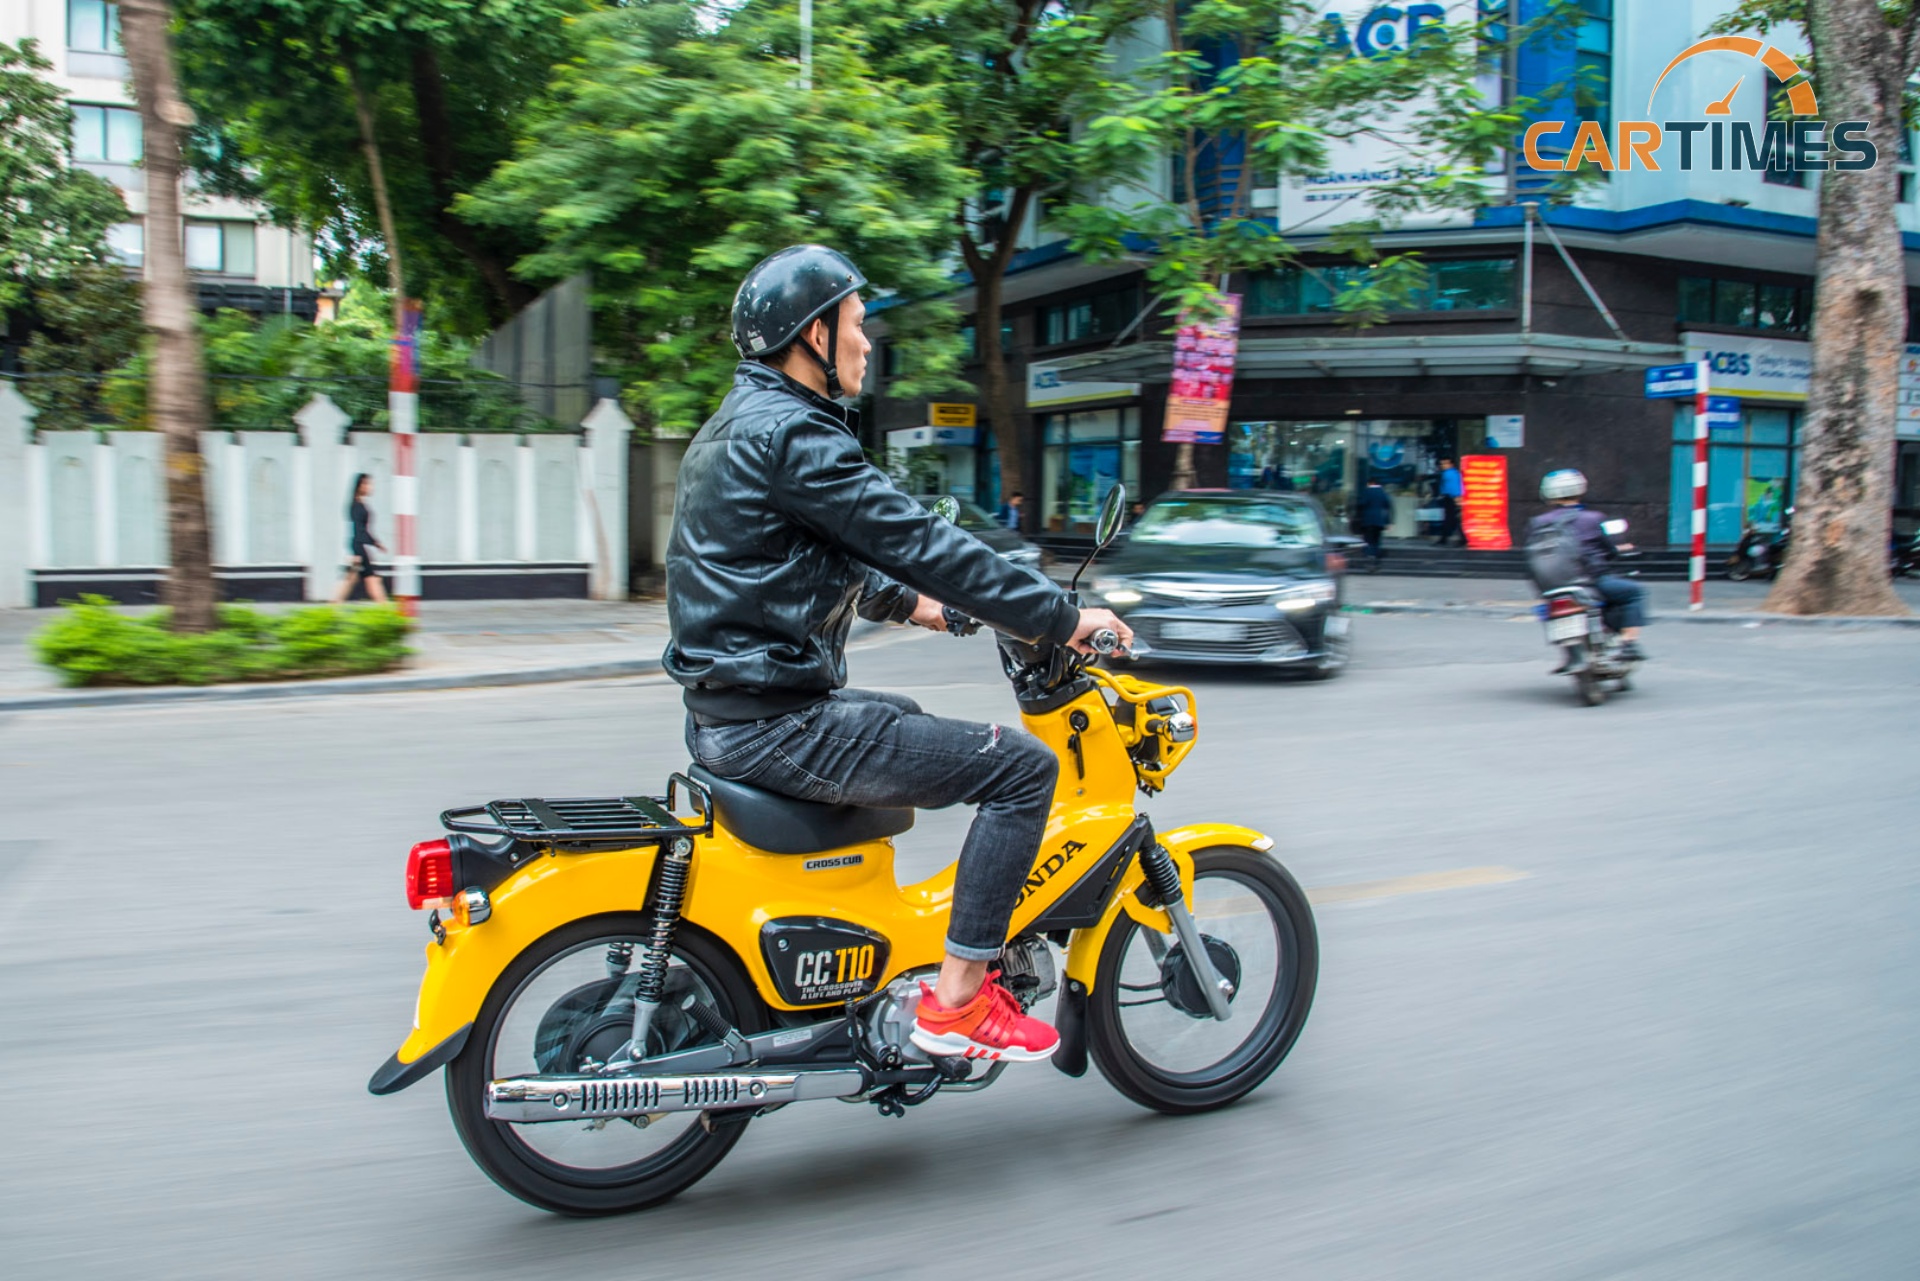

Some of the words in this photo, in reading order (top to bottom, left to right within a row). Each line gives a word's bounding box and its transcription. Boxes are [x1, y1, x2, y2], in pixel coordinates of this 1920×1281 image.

[806, 858, 841, 869] CROSS
[842, 854, 863, 866] CUB
[1013, 840, 1088, 910] NDA
[802, 986, 816, 994] THE
